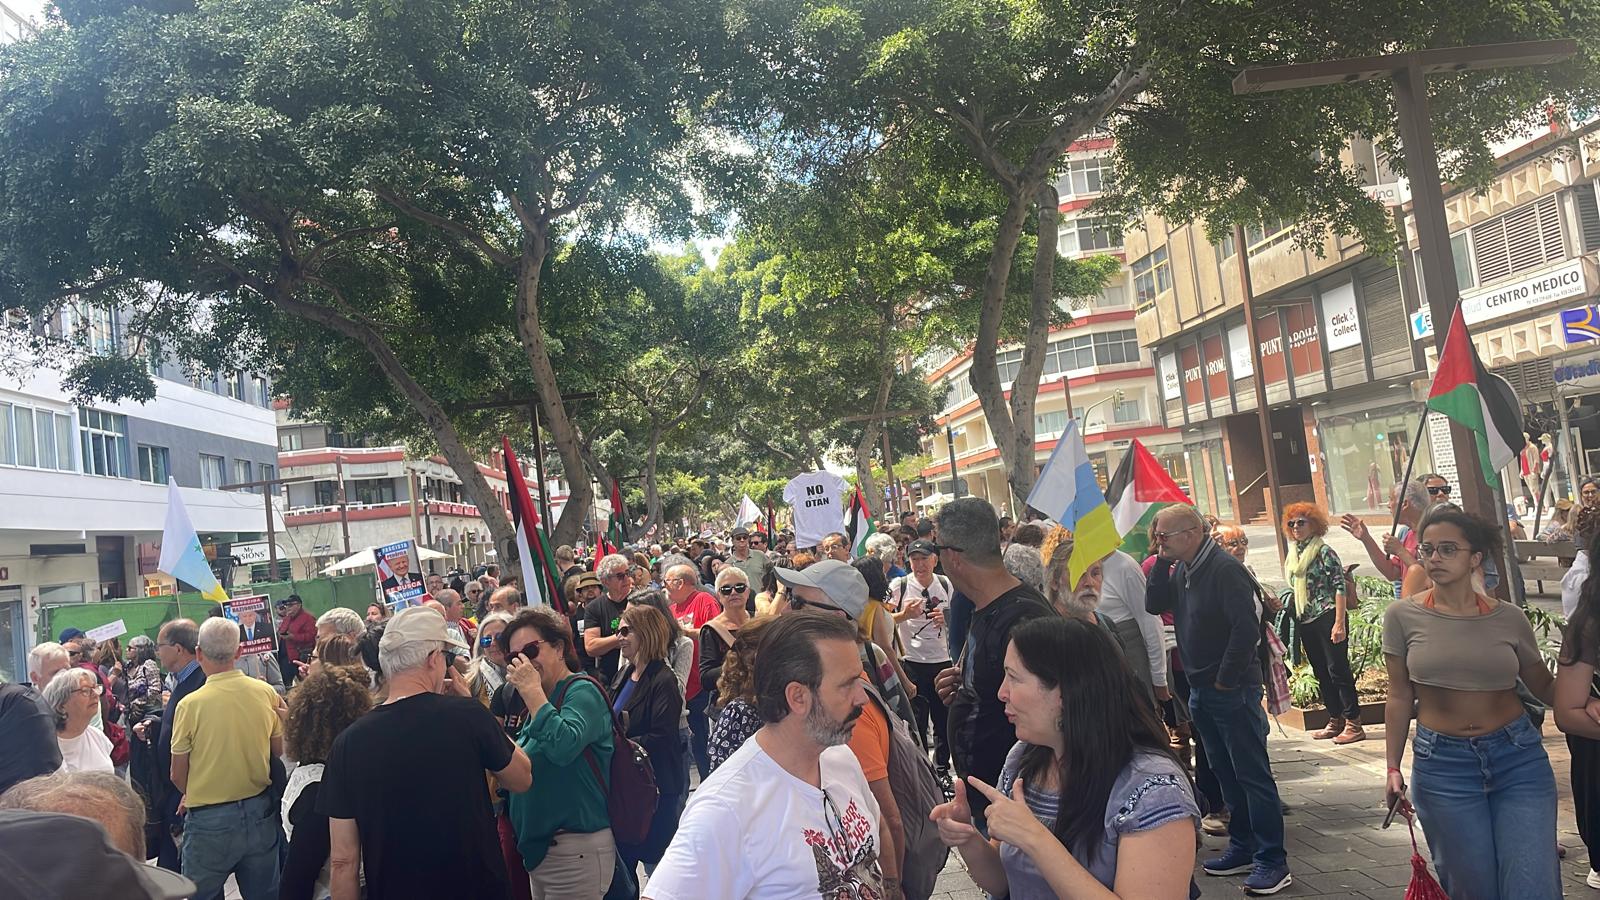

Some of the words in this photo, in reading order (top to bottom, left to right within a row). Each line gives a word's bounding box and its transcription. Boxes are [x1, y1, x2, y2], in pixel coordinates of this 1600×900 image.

[1486, 286, 1529, 308] CENTRO
[1532, 270, 1580, 295] MEDICO
[1331, 312, 1349, 326] Click
[1333, 322, 1358, 337] Collect
[1184, 365, 1209, 383] PUNT
[806, 484, 824, 496] NO
[805, 497, 829, 508] OTAN
[240, 551, 265, 560] SIONS
[398, 580, 422, 590] BUSCA
[31, 596, 36, 608] 5
[246, 637, 272, 646] BUSCA
[242, 644, 271, 653] RIMINAL
